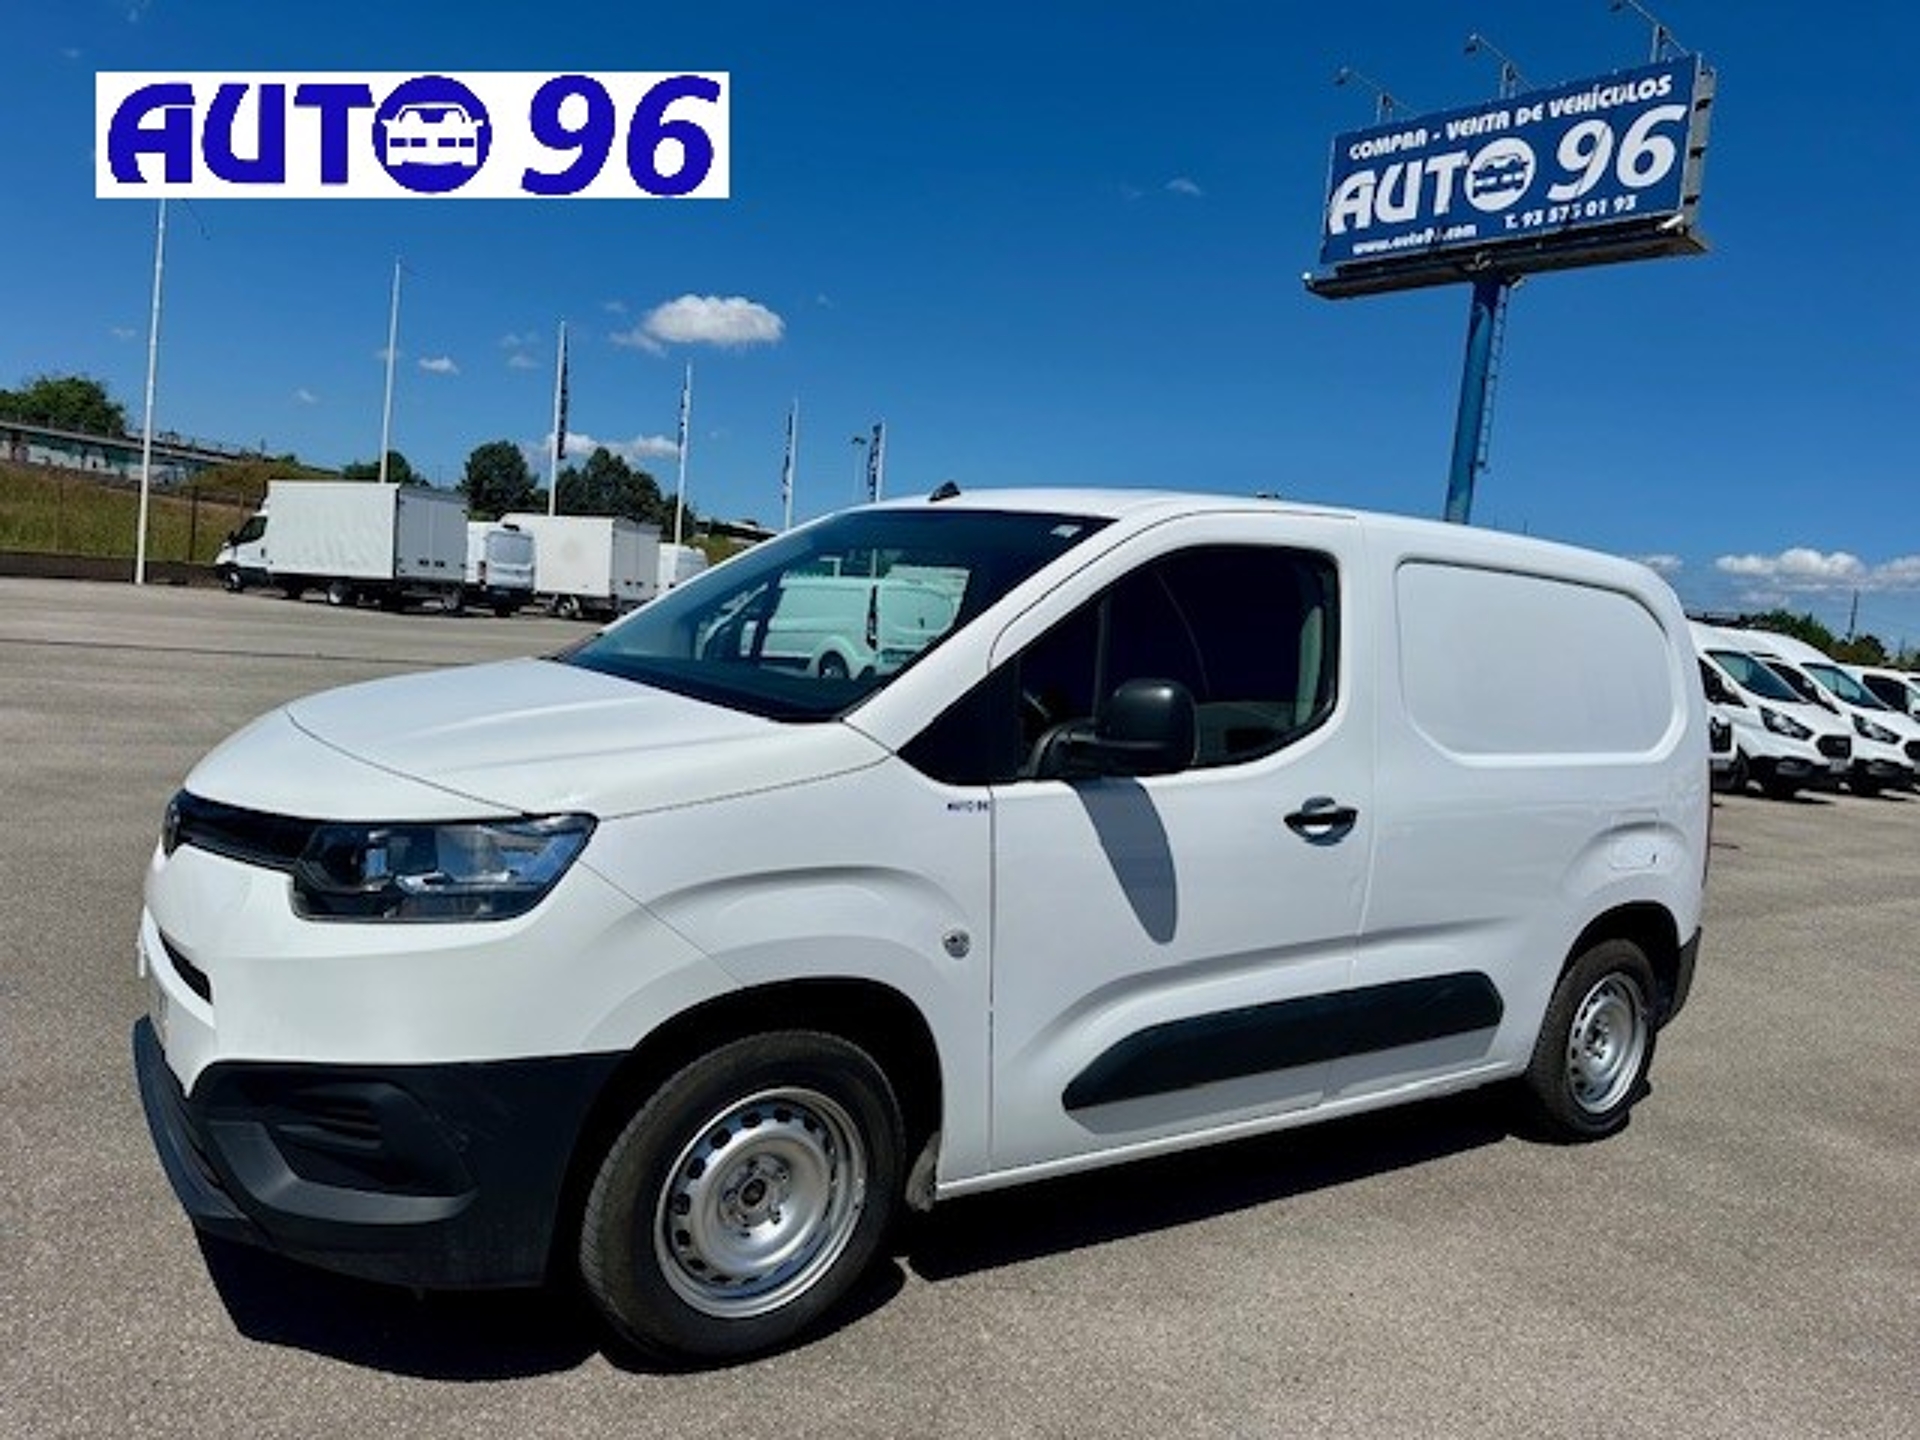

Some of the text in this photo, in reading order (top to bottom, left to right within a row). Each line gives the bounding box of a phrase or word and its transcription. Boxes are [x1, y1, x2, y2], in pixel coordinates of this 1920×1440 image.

[1329, 105, 1687, 235] AUTO 96
[1350, 128, 1427, 160] COMPRA
[1446, 110, 1510, 141] VENTA
[1514, 103, 1544, 127] DE
[1549, 74, 1672, 118] VEHÍCULOS
